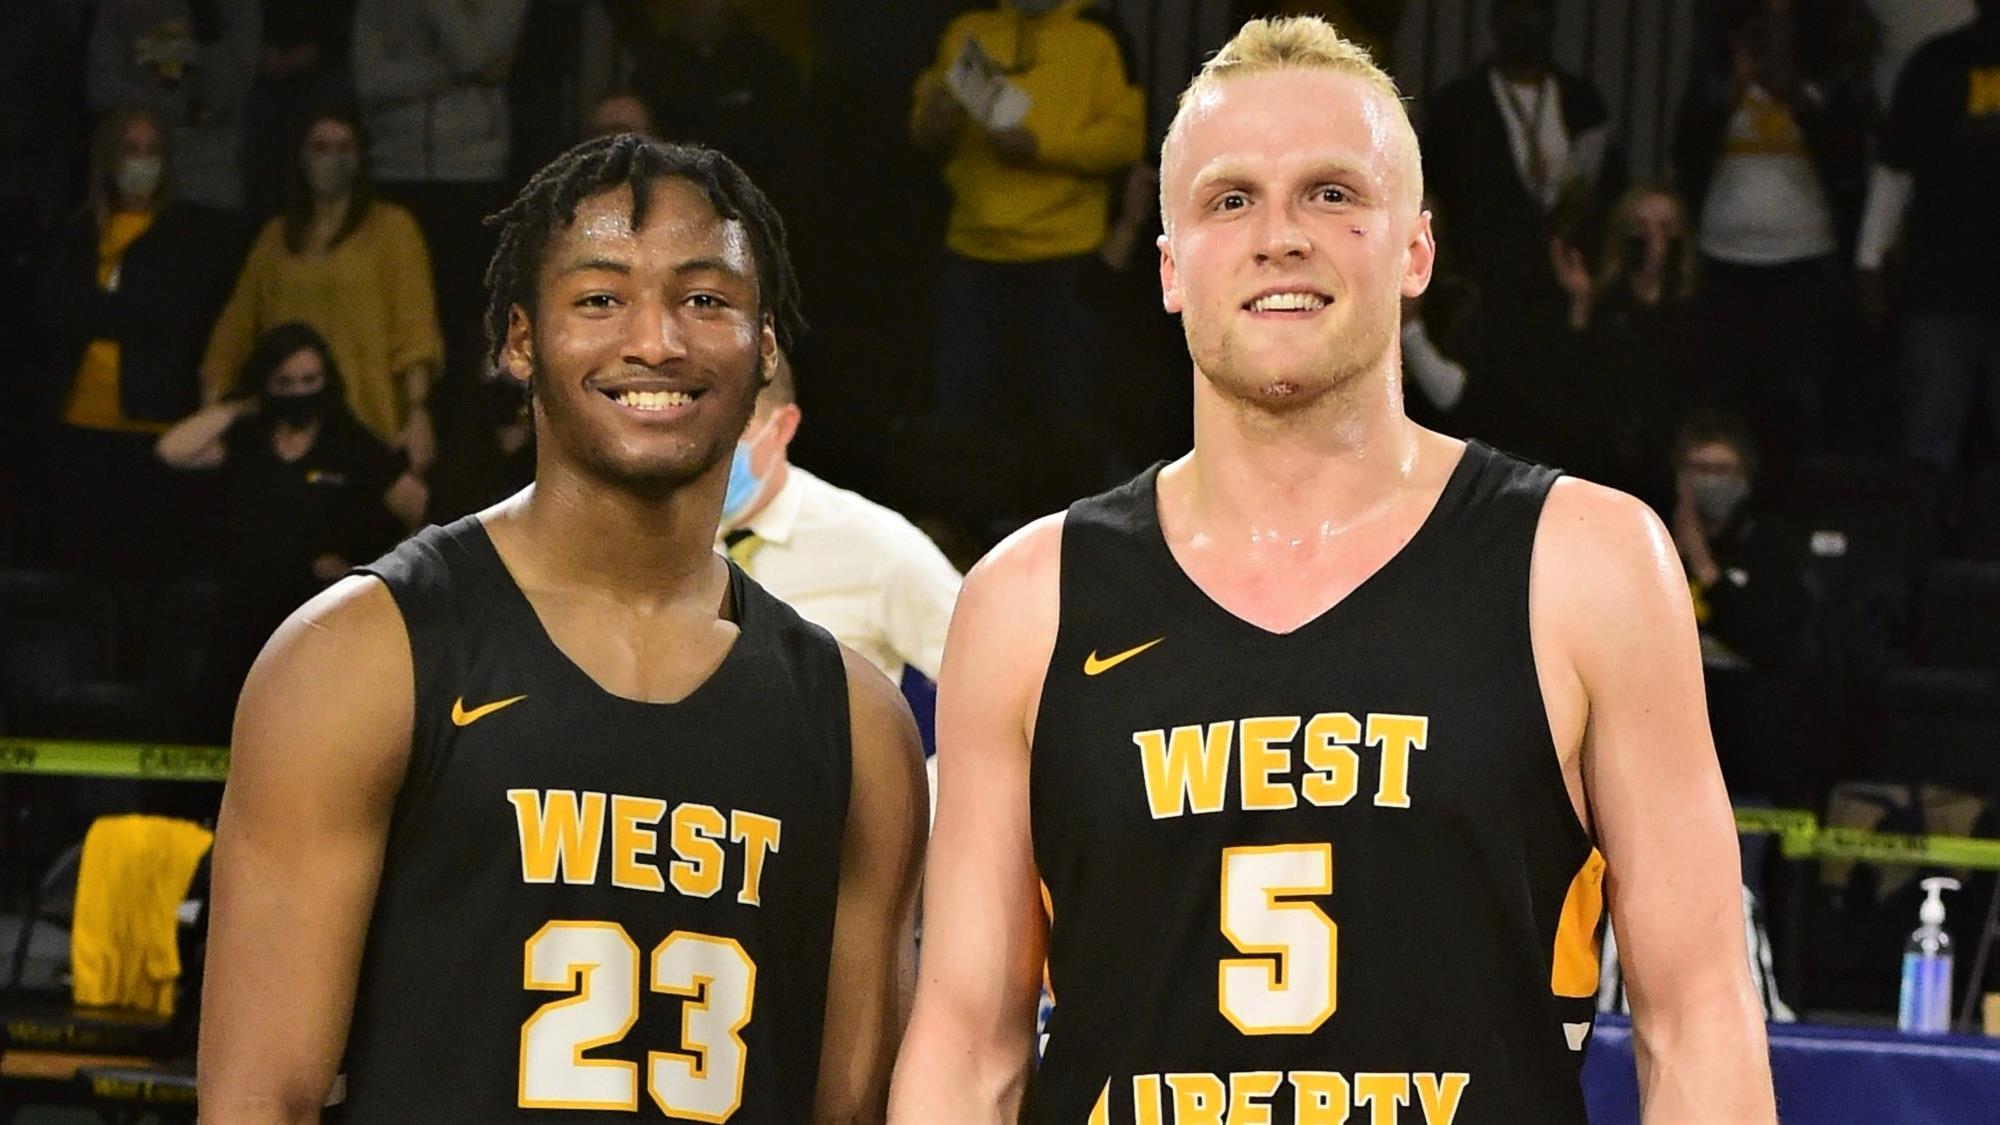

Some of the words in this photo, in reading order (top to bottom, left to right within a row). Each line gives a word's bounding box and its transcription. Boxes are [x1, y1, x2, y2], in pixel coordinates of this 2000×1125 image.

[1133, 712, 1428, 819] WEST
[507, 789, 781, 907] WEST
[1219, 843, 1337, 1036] 5
[518, 920, 757, 1125] 23
